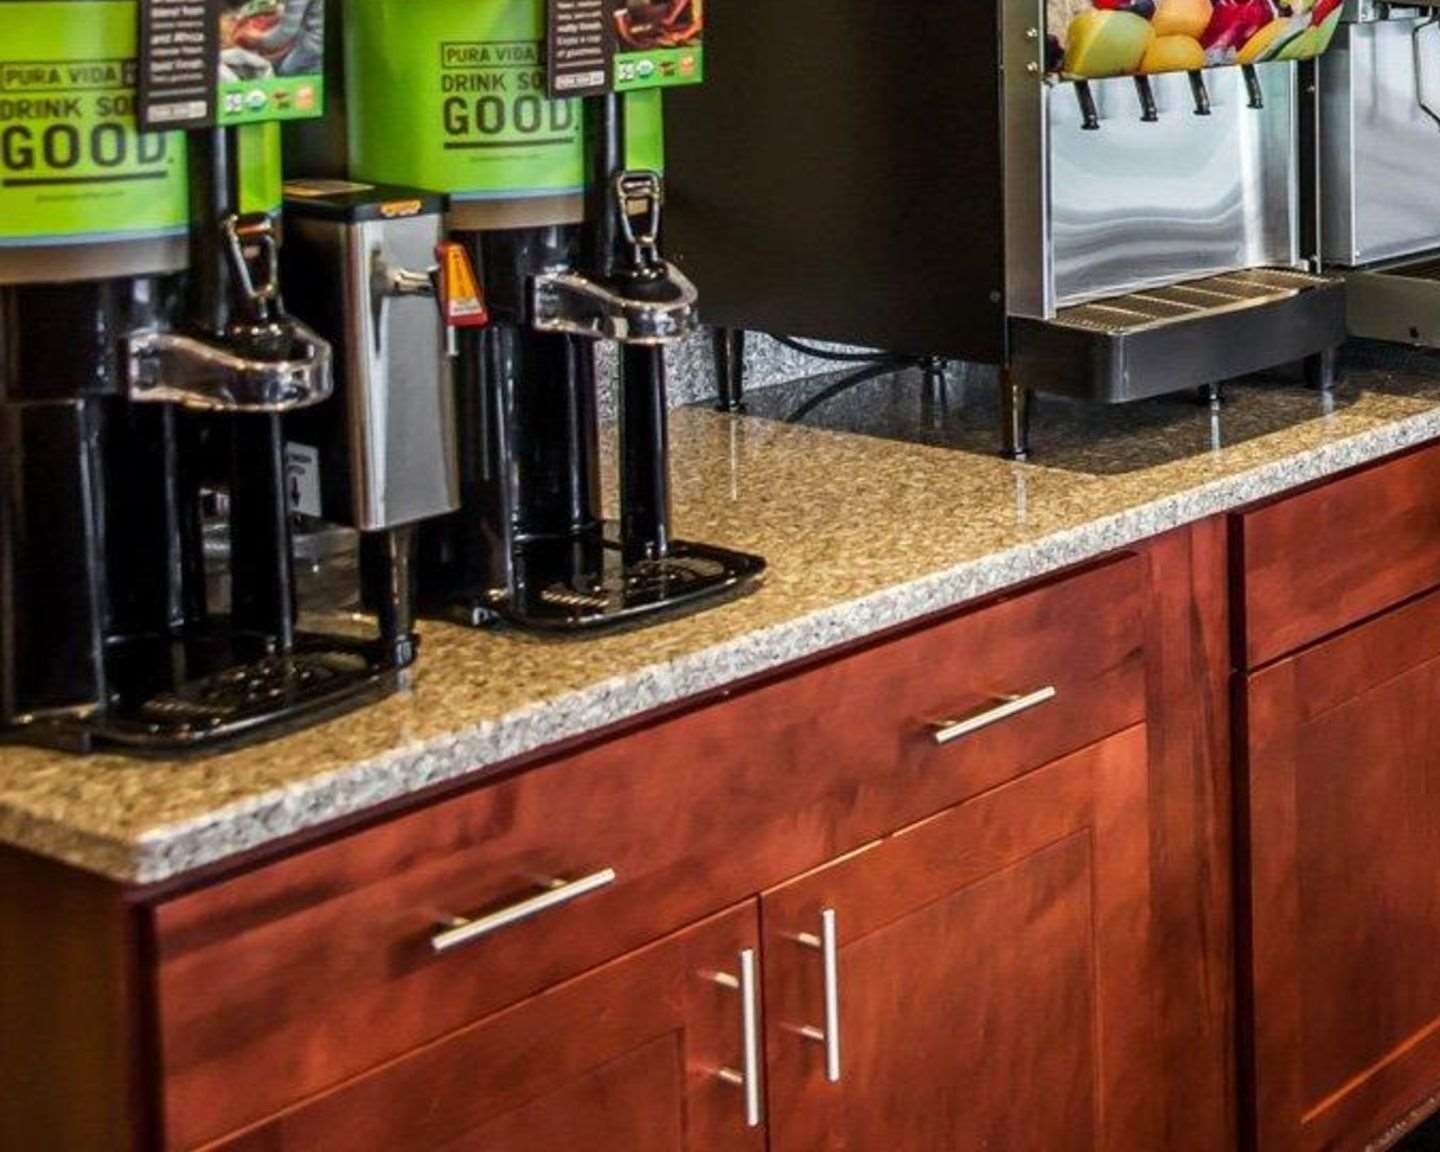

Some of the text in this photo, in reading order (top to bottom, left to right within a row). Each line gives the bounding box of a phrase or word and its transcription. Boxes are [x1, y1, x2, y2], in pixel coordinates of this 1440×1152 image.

[447, 45, 536, 62] PURA VIDA
[5, 67, 62, 85] PURA
[68, 65, 117, 82] VIDA
[442, 73, 507, 92] DRINK
[517, 70, 545, 91] SO
[0, 98, 82, 121] DRINK
[96, 95, 136, 116] SO
